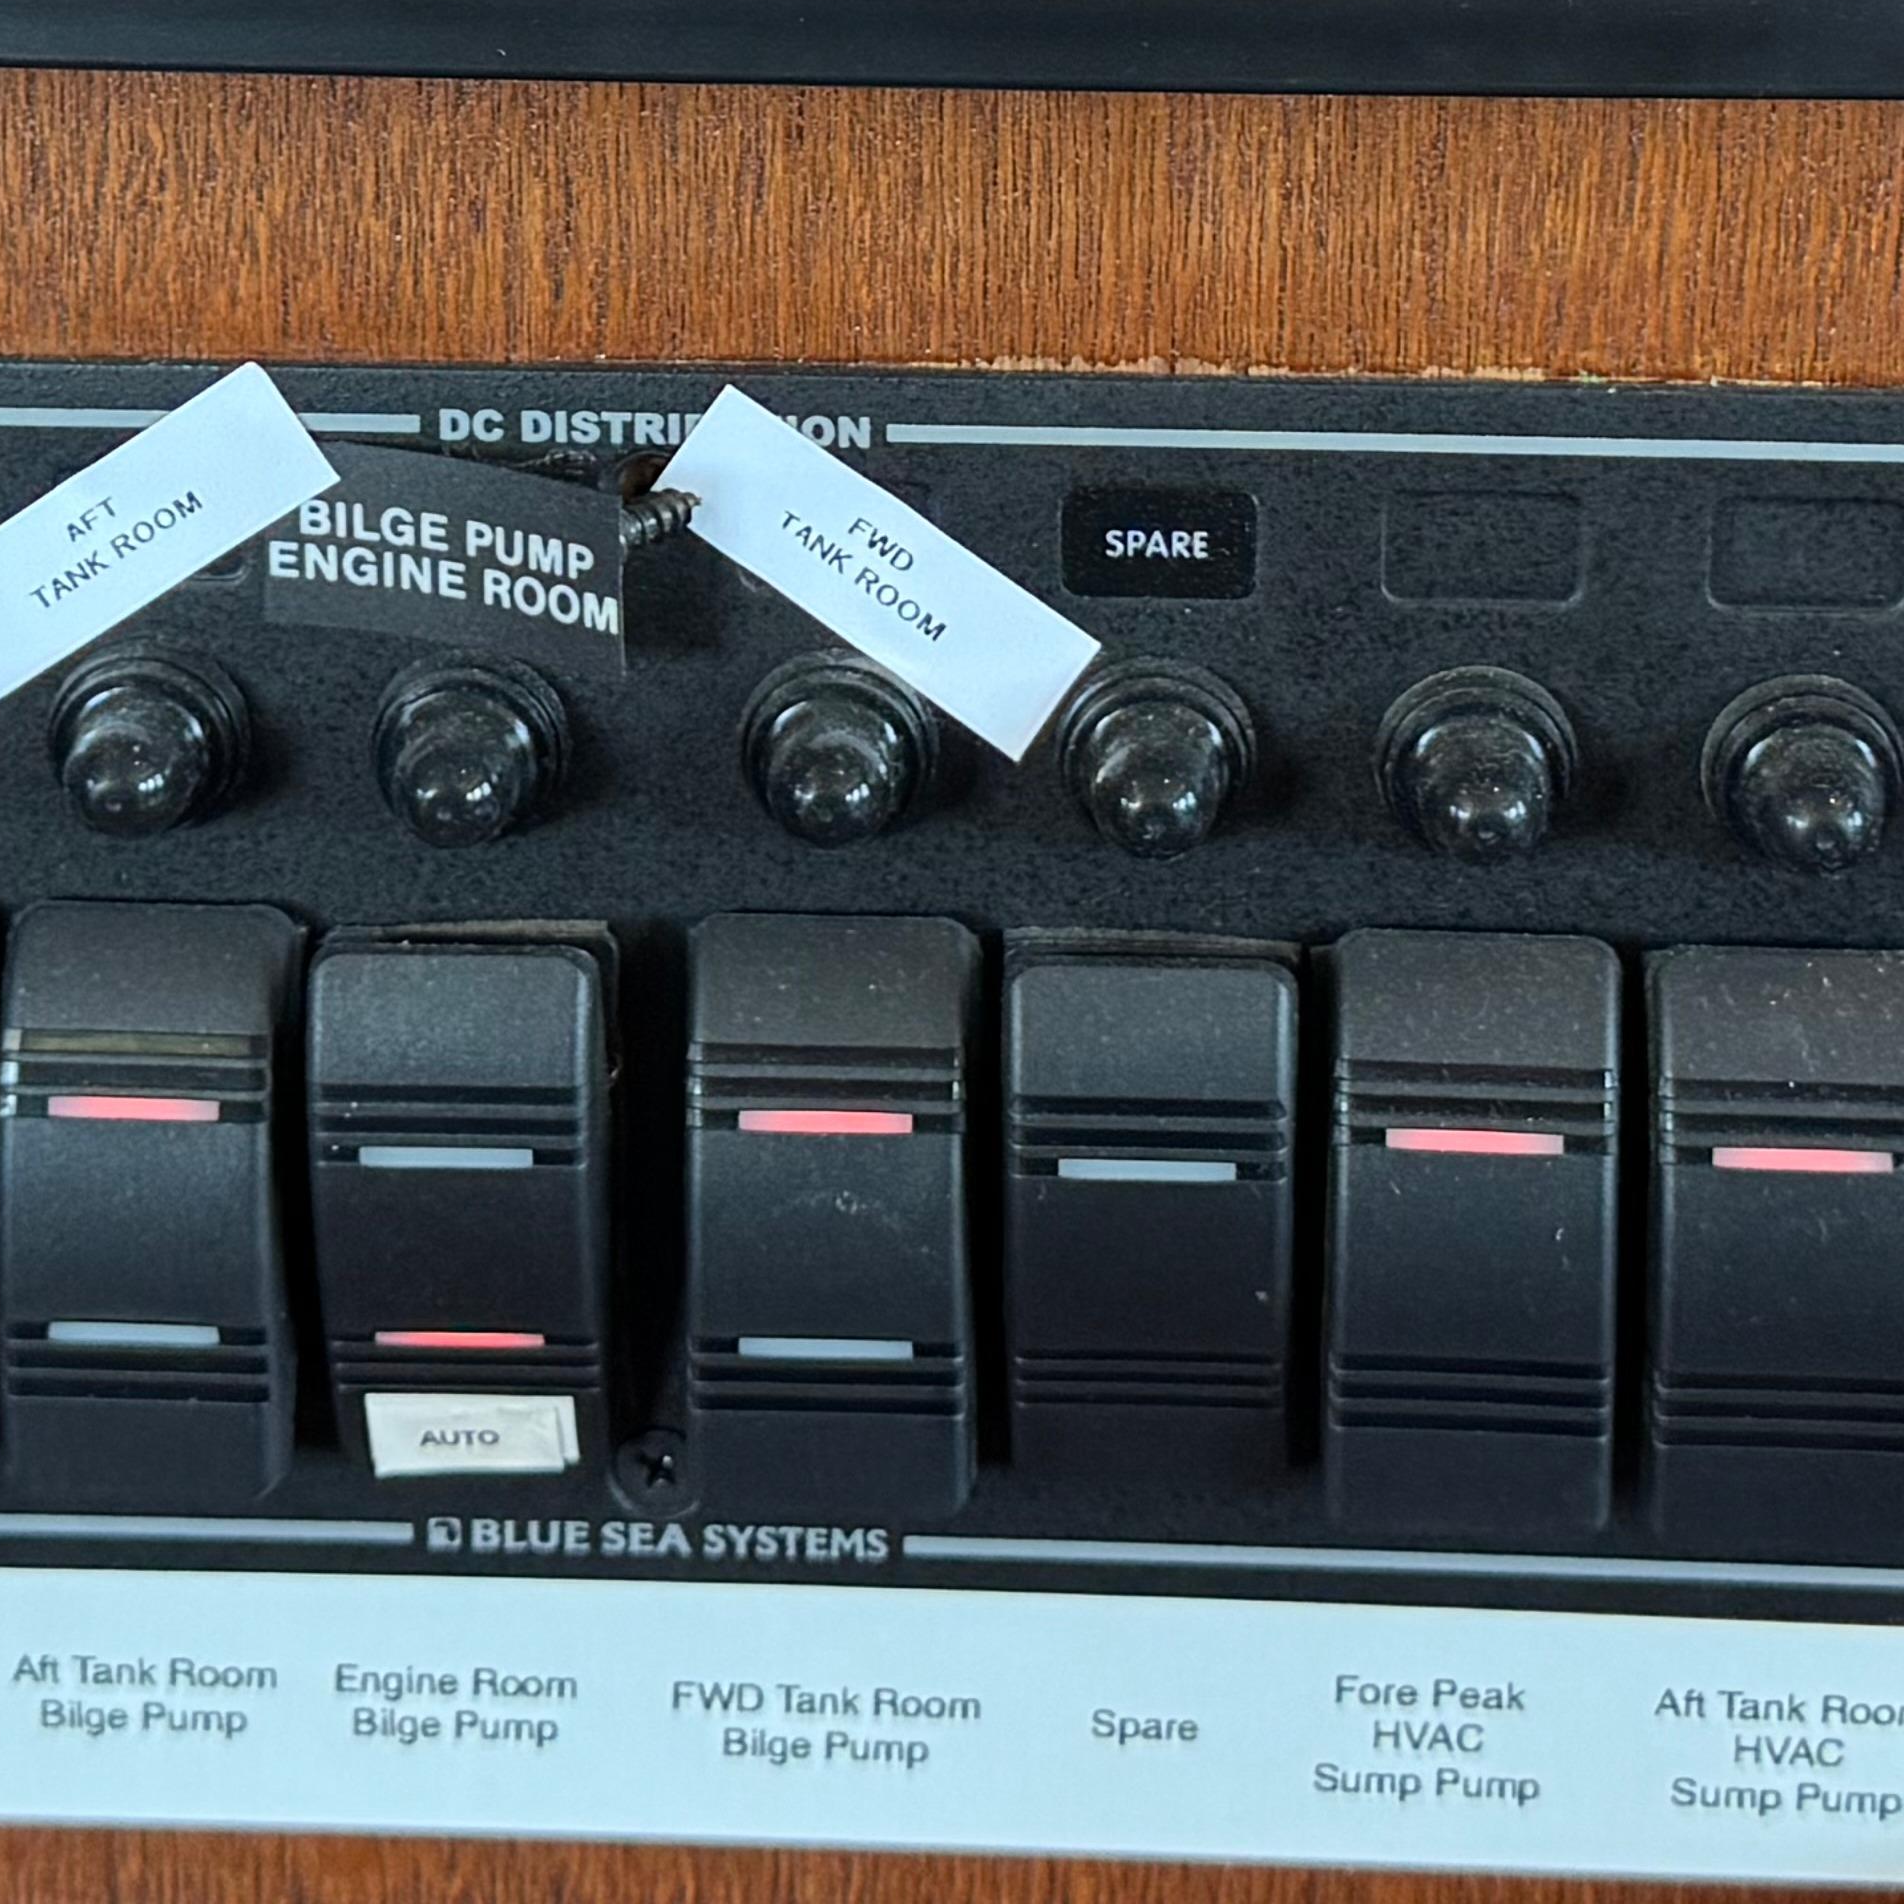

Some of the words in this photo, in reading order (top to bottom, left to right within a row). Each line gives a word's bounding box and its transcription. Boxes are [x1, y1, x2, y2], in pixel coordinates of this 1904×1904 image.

[438, 408, 505, 444] DC
[520, 410, 871, 450] DISTRION
[65, 496, 118, 545] AFT
[299, 500, 451, 553] BILGE
[465, 526, 596, 582] PUMP
[29, 549, 112, 611] TANK
[109, 489, 206, 560] ROOM
[847, 516, 915, 573] FWD
[1105, 529, 1210, 561] SPARE
[268, 539, 470, 601] ENGINE
[482, 570, 620, 638] ROOM
[779, 510, 849, 577] TANK
[853, 566, 948, 644] ROOM
[419, 1427, 501, 1449] AUTO
[471, 1519, 591, 1554] BLUE
[601, 1522, 693, 1557] SEA
[702, 1525, 889, 1561] SYSTEMS
[12, 1654, 62, 1685] Aft
[72, 1656, 157, 1688] Tank
[168, 1658, 279, 1690] Room
[335, 1664, 460, 1701] Engine
[472, 1668, 579, 1700] Room
[671, 1680, 765, 1713] FWD
[777, 1684, 861, 1717] Tank
[873, 1687, 982, 1721] Room
[1334, 1674, 1418, 1707] Fore
[1432, 1678, 1527, 1712] Peak
[1654, 1687, 1707, 1720] Aft
[1717, 1690, 1806, 1724] Tank
[40, 1699, 129, 1736] Bilge
[142, 1702, 249, 1740] Pump
[352, 1708, 442, 1746] Bilge
[454, 1710, 560, 1749] Pump
[1090, 1709, 1199, 1748] Spare
[1372, 1720, 1485, 1753] HVAC
[722, 1728, 812, 1765] Bilge
[824, 1731, 930, 1770] Pump
[1733, 1735, 1846, 1768] HVAC
[1312, 1763, 1422, 1801] Sump
[1435, 1767, 1541, 1805] Pump
[1670, 1777, 1783, 1816] Sump
[1796, 1781, 1903, 1821] Pump
